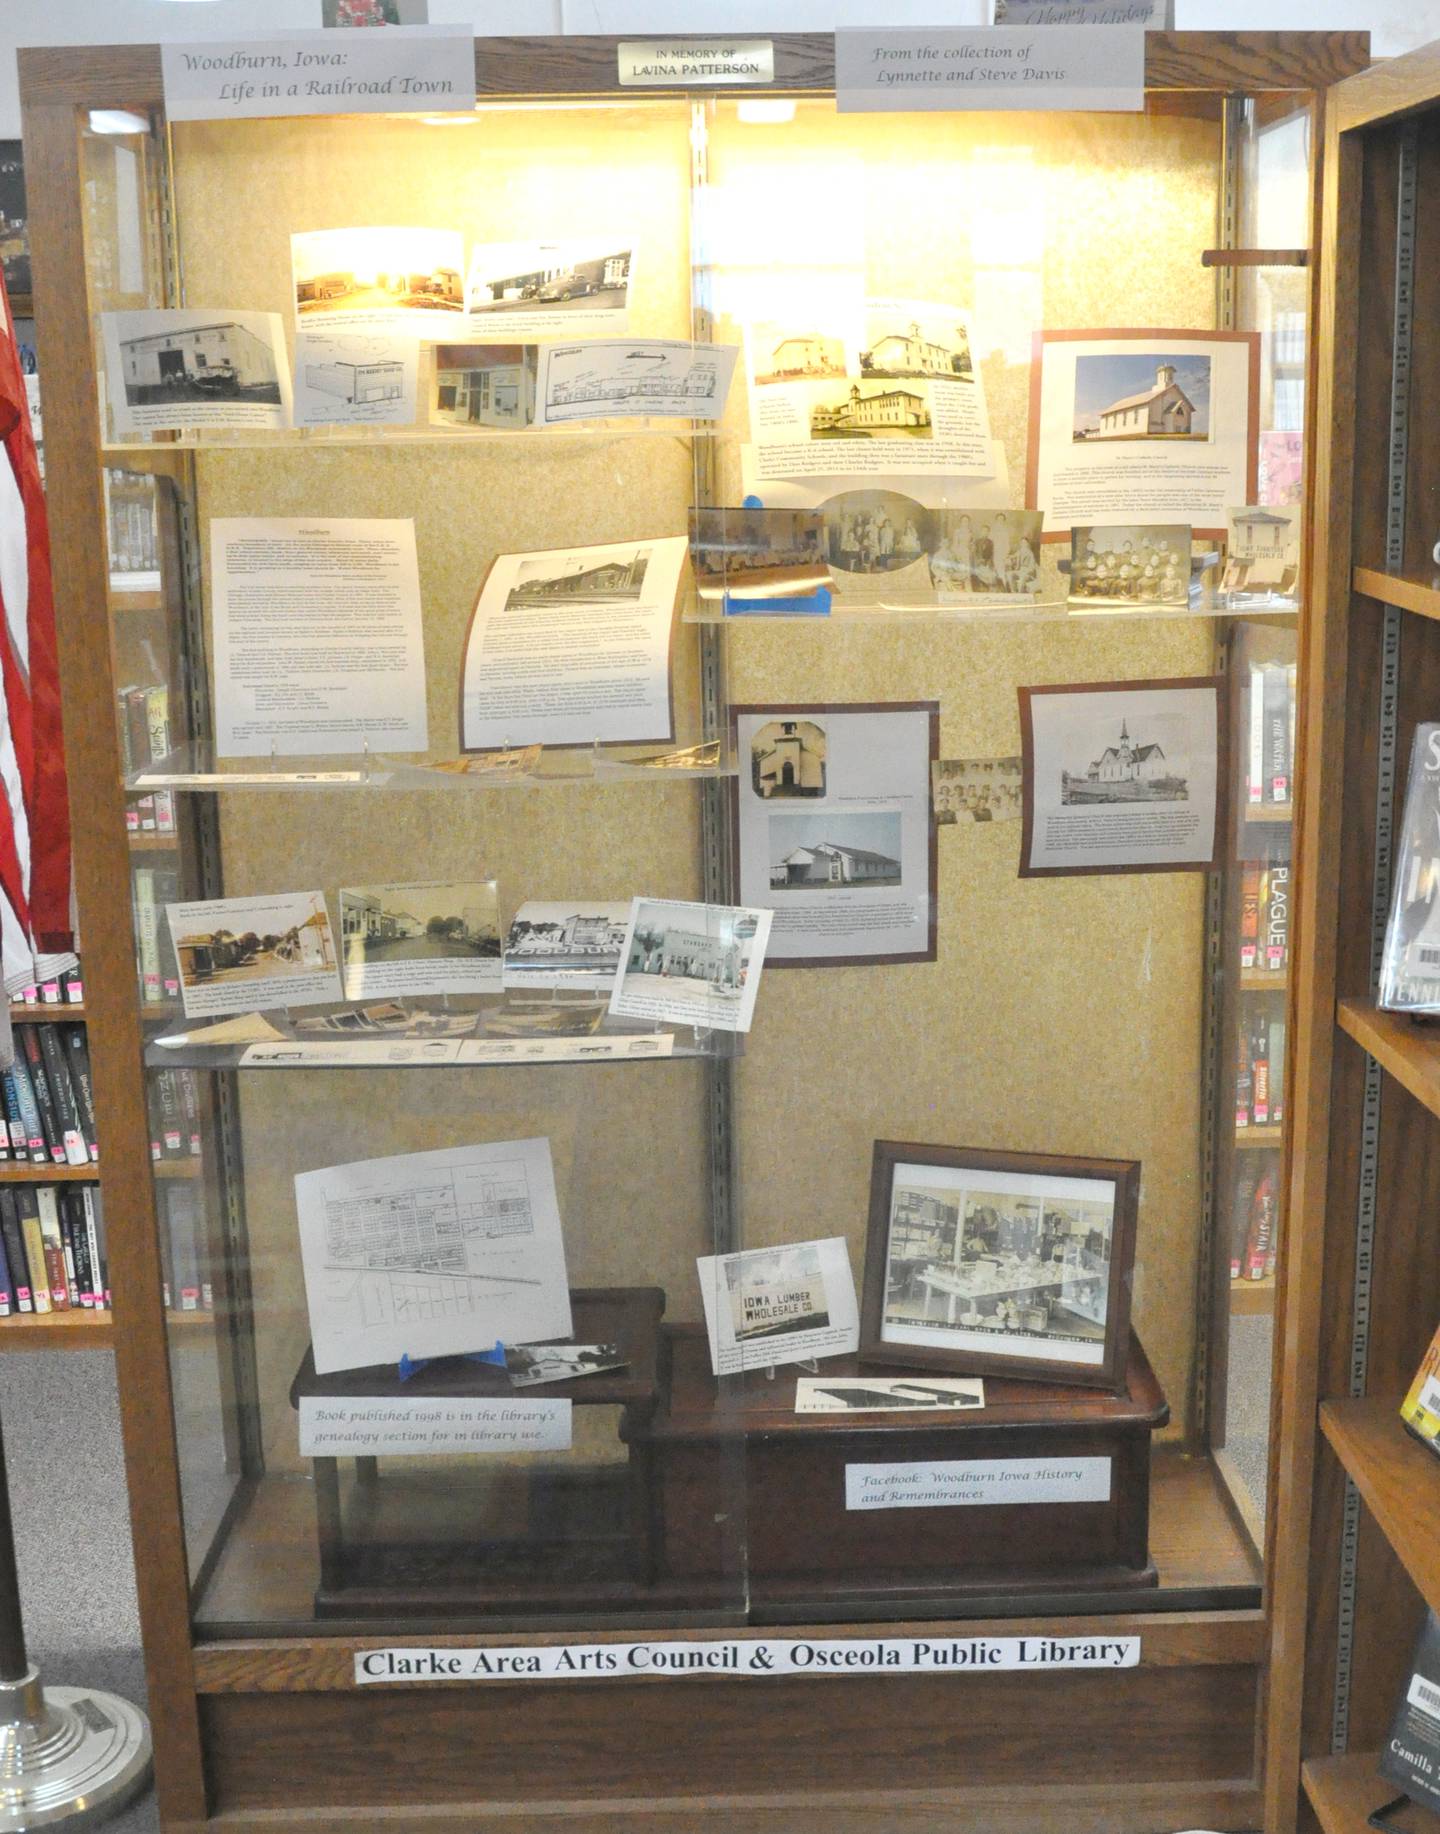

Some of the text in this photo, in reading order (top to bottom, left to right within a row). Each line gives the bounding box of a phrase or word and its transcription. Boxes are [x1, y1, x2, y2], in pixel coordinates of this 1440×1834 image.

[181, 50, 348, 71] Woodburn, Iowa:
[656, 49, 736, 59] IN MEMORY OF
[872, 43, 1034, 63] From the collection of
[633, 63, 760, 76] LAVINA PATTERSON
[876, 66, 1066, 87] Lynnette and Steve Davis
[218, 76, 454, 104] Life in a Railroad Town
[1267, 866, 1289, 946] PLAGUE
[743, 1291, 811, 1309] IOWA LUMBER
[745, 1306, 799, 1322] WHOLESALE
[314, 1408, 556, 1425] Book published 1998 is in the library's
[314, 1430, 379, 1444] genealogy
[382, 1430, 427, 1442] section
[430, 1429, 450, 1444] for
[453, 1431, 467, 1442] in
[470, 1429, 518, 1442] library
[860, 1468, 1084, 1488] Facebook: Woodburn Iowa History
[861, 1488, 986, 1504] and Remembrances
[361, 1640, 1131, 1676] Clarke Area Arts Council & Osceola Public Library
[1389, 1738, 1433, 1774] Camilla
